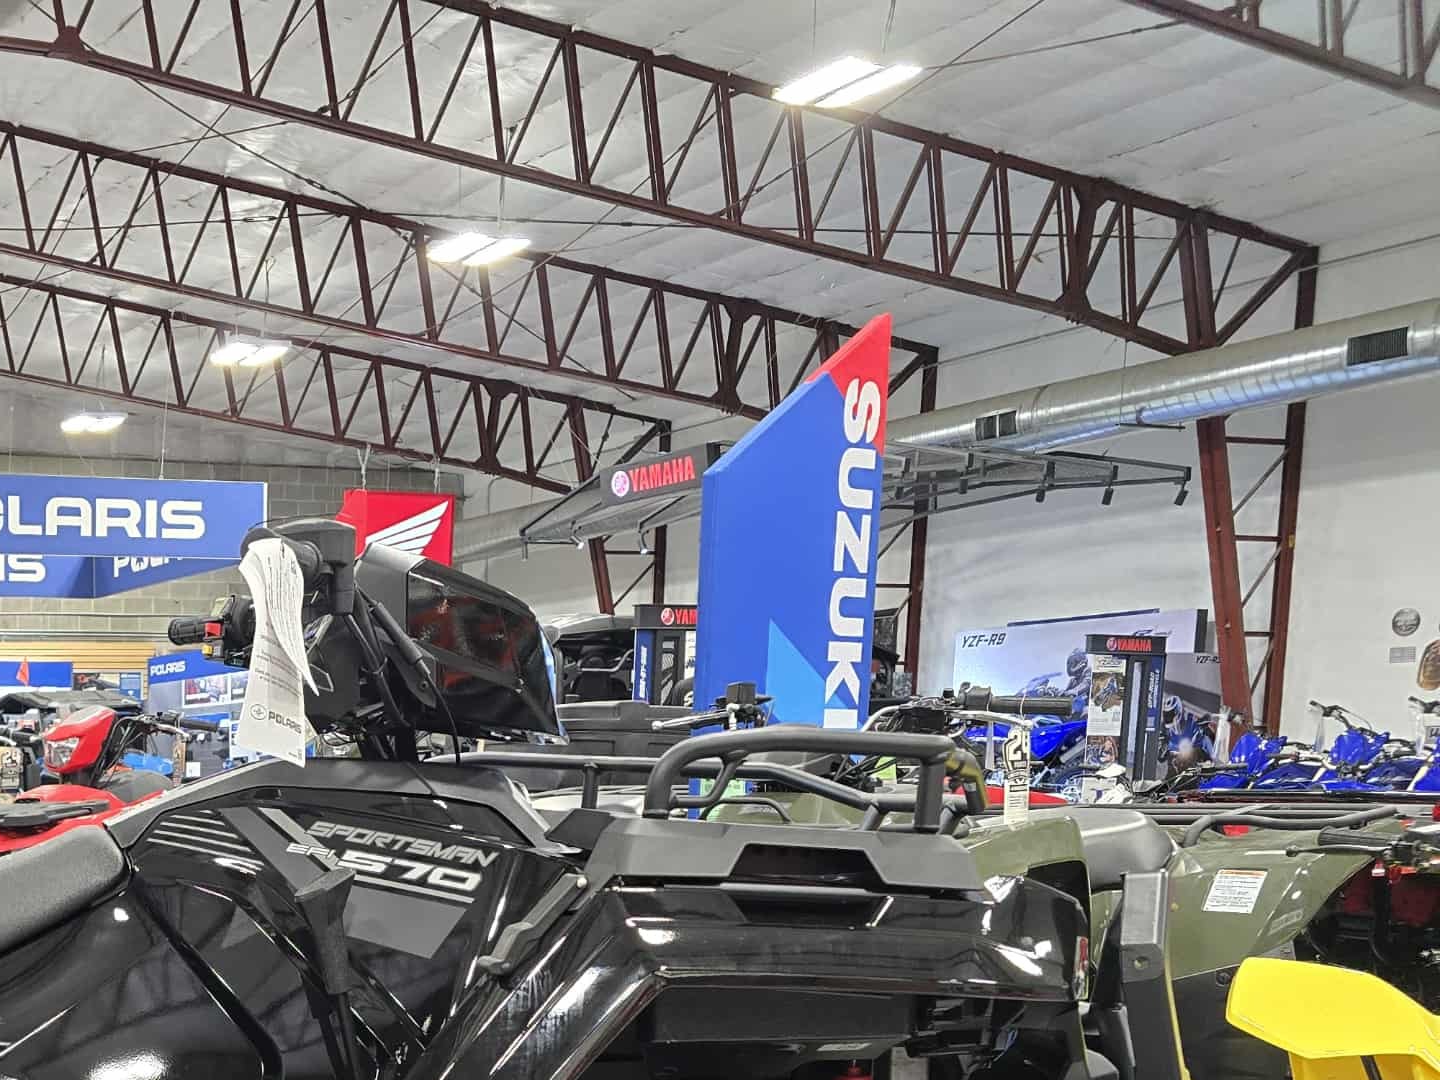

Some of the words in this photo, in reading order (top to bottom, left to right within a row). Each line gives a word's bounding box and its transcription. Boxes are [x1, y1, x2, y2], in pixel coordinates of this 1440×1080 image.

[629, 455, 696, 492] YAMAHA
[823, 377, 881, 729] SUZUKI
[675, 608, 698, 624] YAM
[961, 632, 1007, 648] YZF-R9
[1117, 638, 1152, 651] YAMAHA
[150, 660, 187, 676] POLARIS
[268, 711, 302, 734] POLARIS
[305, 821, 500, 867] SPORTSMAN
[335, 850, 483, 891] 570
